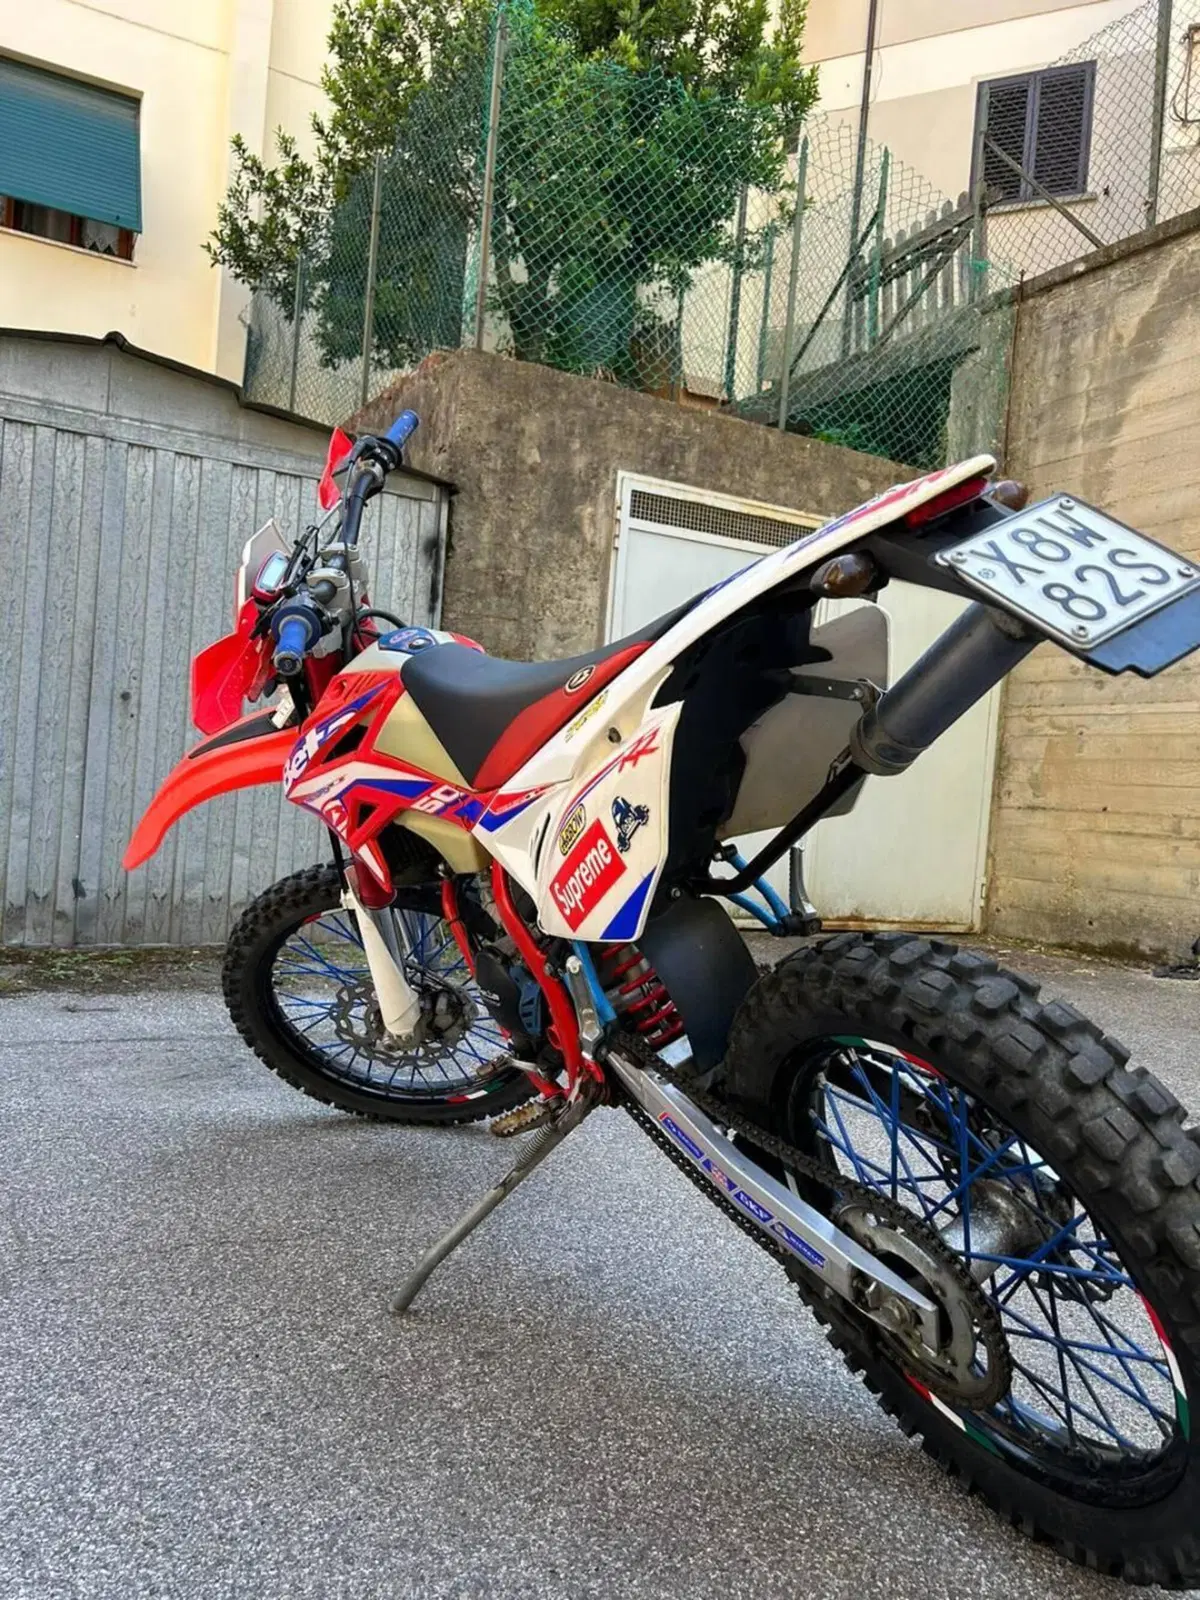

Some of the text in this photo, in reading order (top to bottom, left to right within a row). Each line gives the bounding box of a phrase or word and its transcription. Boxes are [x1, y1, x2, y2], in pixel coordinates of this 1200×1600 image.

[969, 509, 1108, 585] X8W
[1041, 547, 1171, 622] 82S
[553, 837, 613, 915] Supreme
